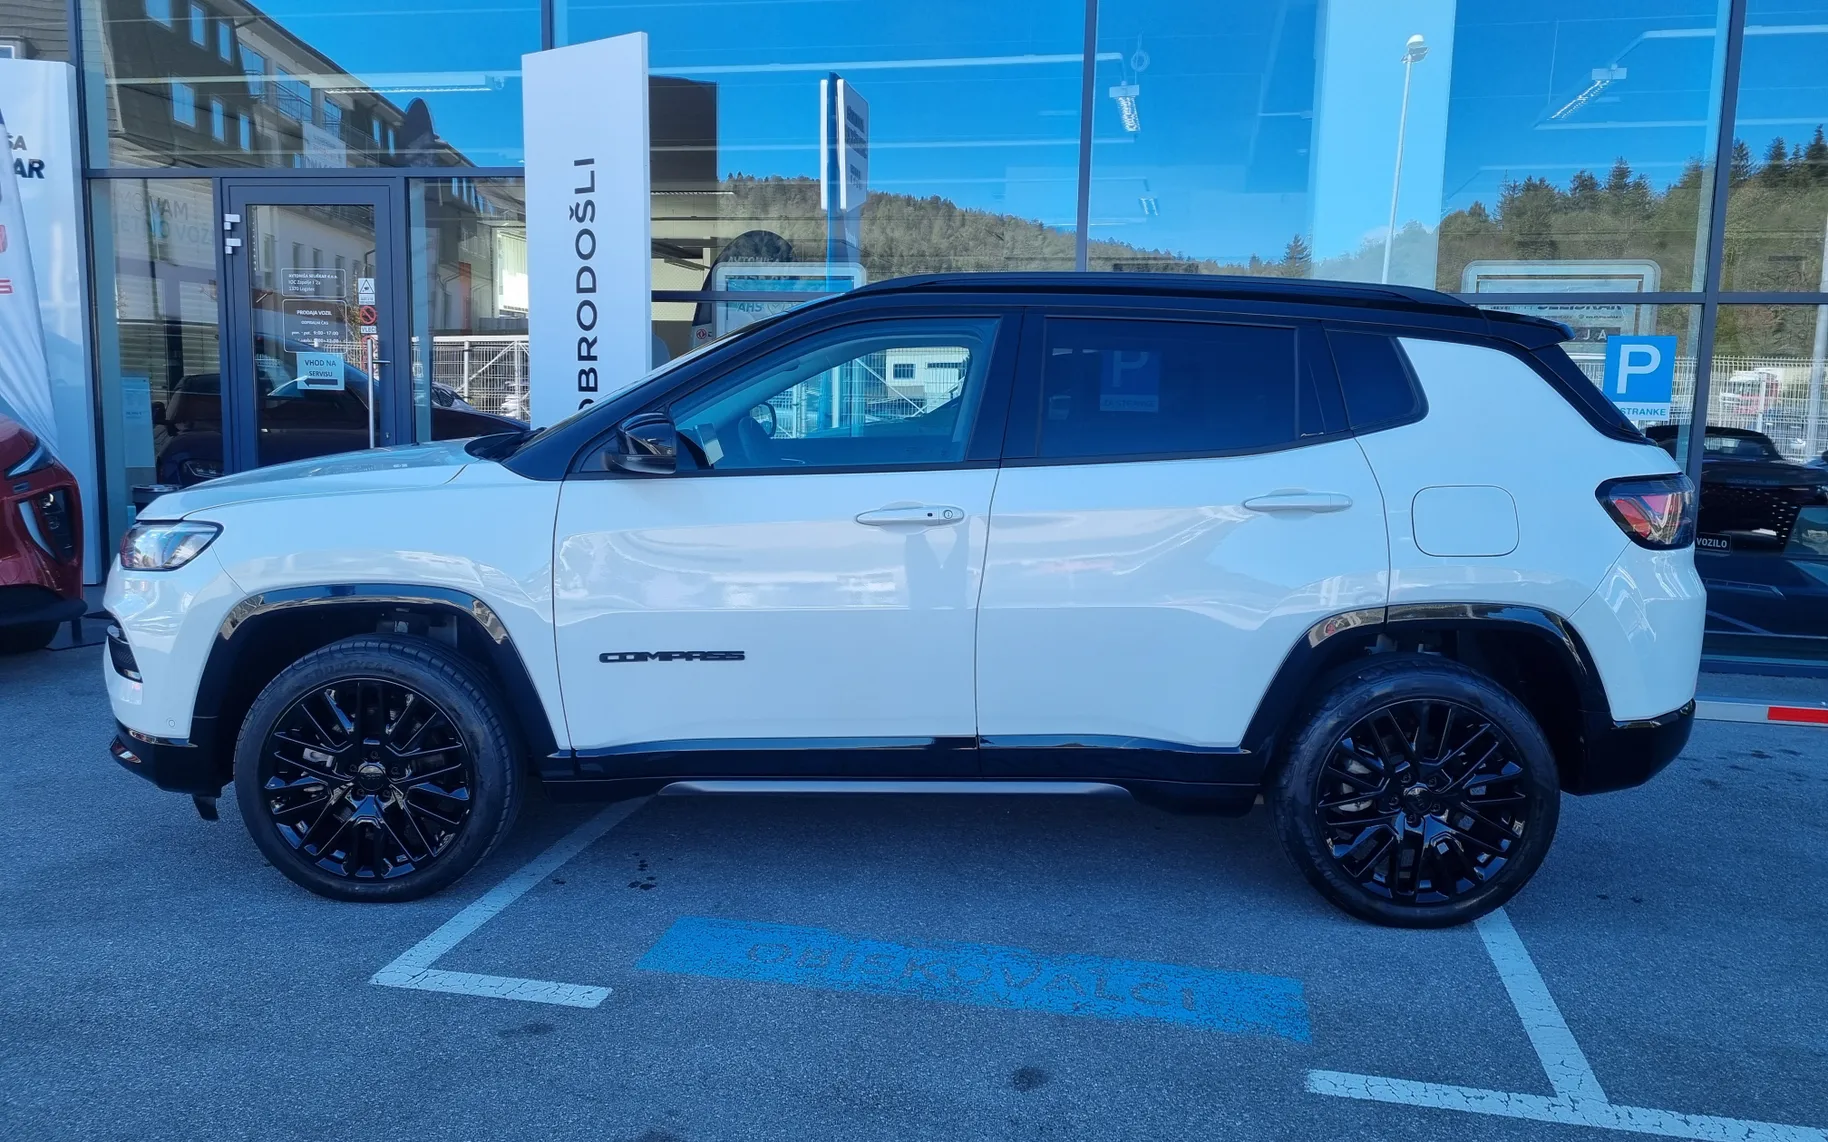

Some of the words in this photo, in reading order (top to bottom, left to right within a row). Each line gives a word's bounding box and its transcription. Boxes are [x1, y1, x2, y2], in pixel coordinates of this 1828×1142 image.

[13, 157, 46, 179] AR
[1574, 328, 1608, 341] JA
[304, 359, 324, 367] VHOD
[1616, 344, 1661, 394] P
[1696, 537, 1728, 548] VOZILO
[598, 650, 746, 664] COMPASS
[748, 942, 1198, 1012] OBISKOVALCI
